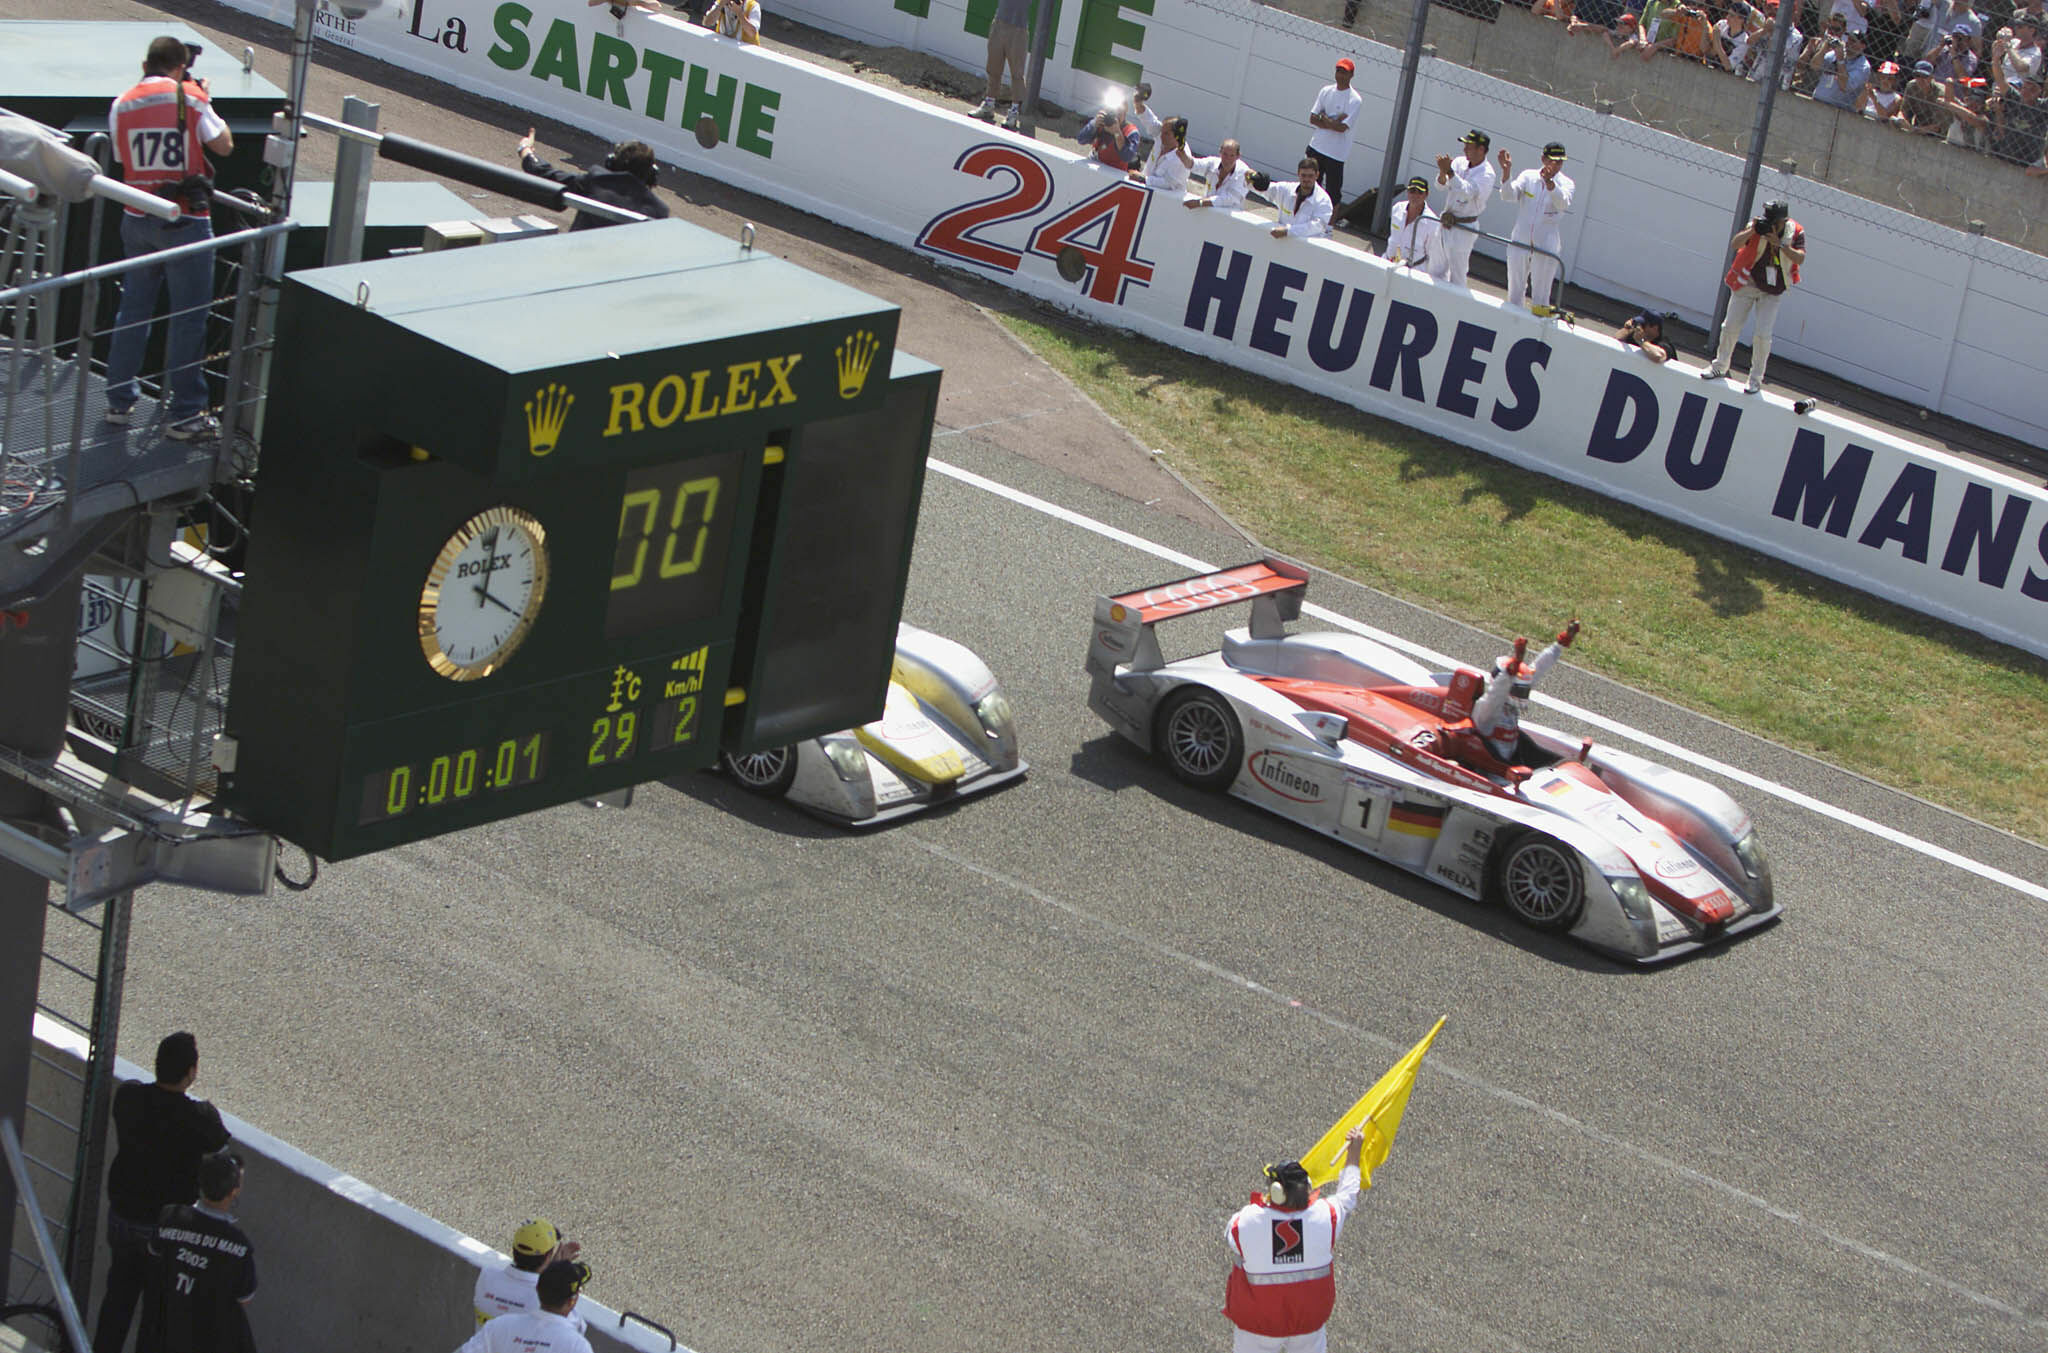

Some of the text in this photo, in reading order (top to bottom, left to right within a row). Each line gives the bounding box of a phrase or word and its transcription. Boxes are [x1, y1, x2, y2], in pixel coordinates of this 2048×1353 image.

[406, 0, 469, 53] La
[487, 2, 782, 160] SARTHE
[132, 131, 183, 168] 178
[914, 142, 1156, 306] 24
[1184, 240, 1552, 431] HEURES
[1586, 368, 1744, 491] DU
[603, 353, 802, 437] ROLEX
[457, 554, 512, 579] ROLEX
[665, 676, 702, 698] Km/h
[588, 712, 636, 766] 29
[674, 696, 696, 743] 2
[386, 733, 541, 815] 0:00:01
[1259, 749, 1320, 798] Infineon
[1358, 798, 1372, 829] 1
[1437, 864, 1477, 892] HELIX
[202, 1235, 218, 1248] DU
[218, 1239, 248, 1257] MANS
[176, 1272, 195, 1295] TV
